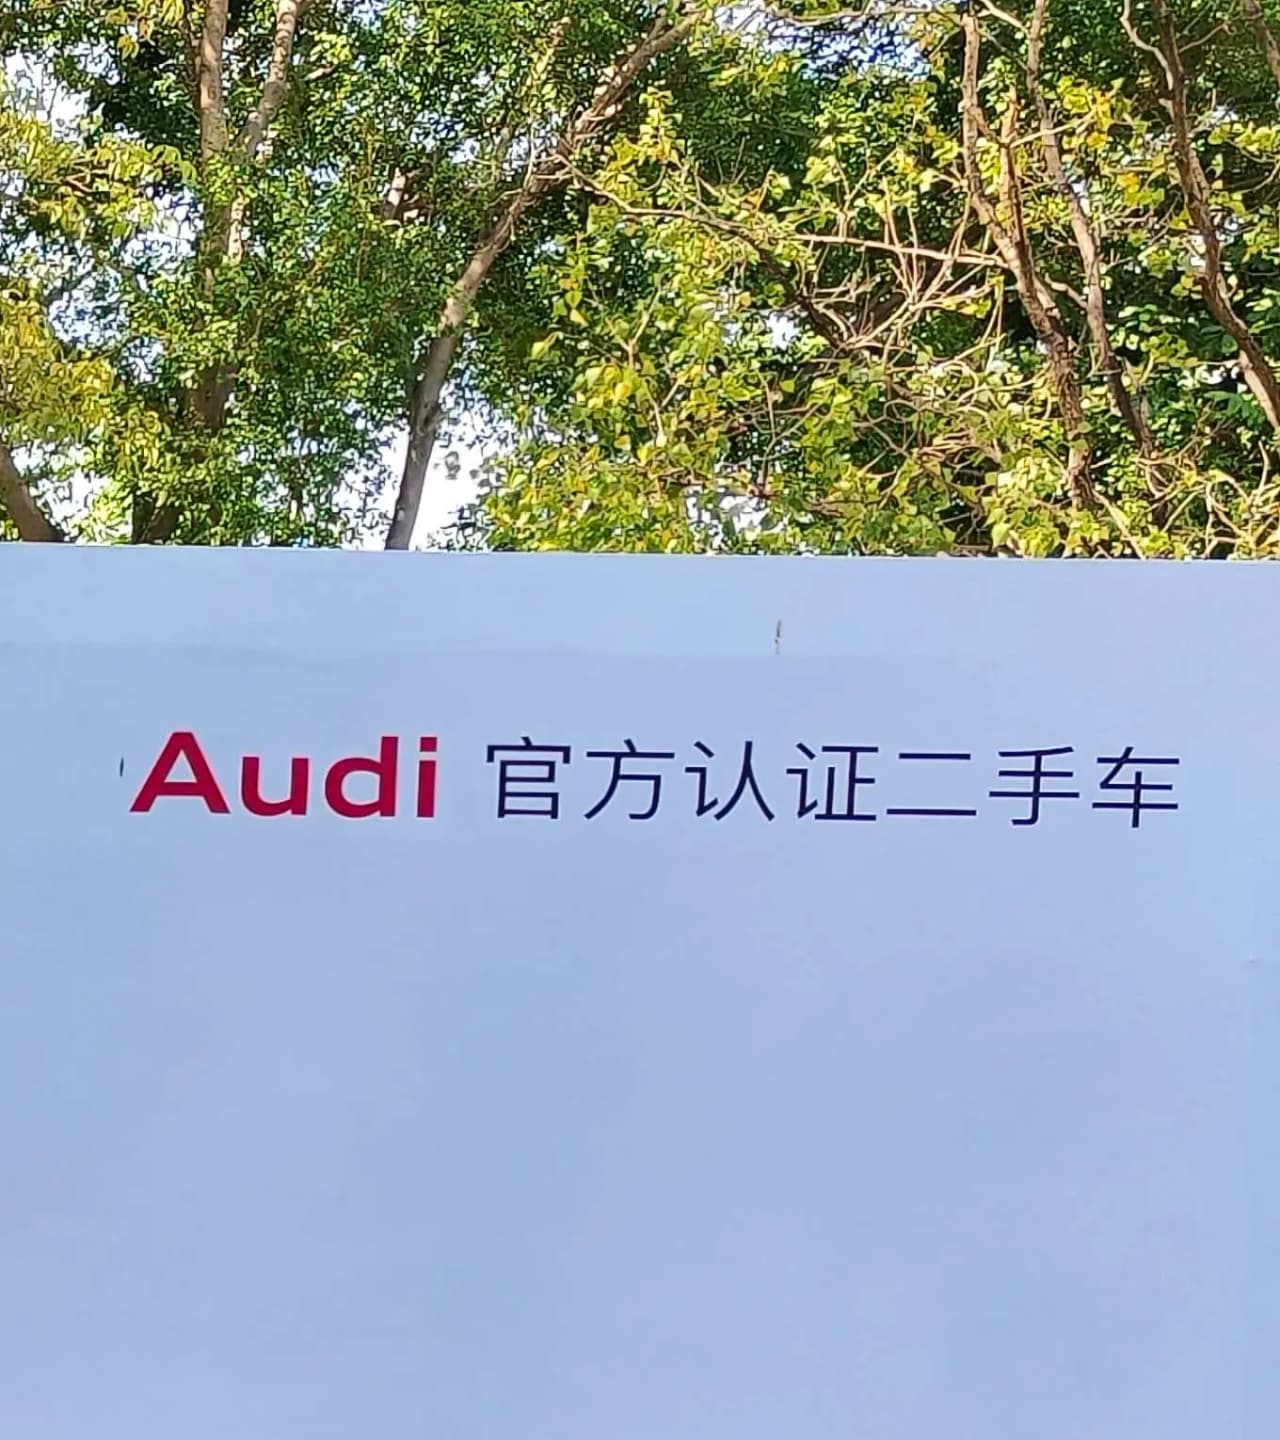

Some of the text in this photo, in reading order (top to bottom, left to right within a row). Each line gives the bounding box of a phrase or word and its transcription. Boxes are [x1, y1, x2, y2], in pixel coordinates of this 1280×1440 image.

[130, 730, 1181, 829] Audi 官方认证二手车
